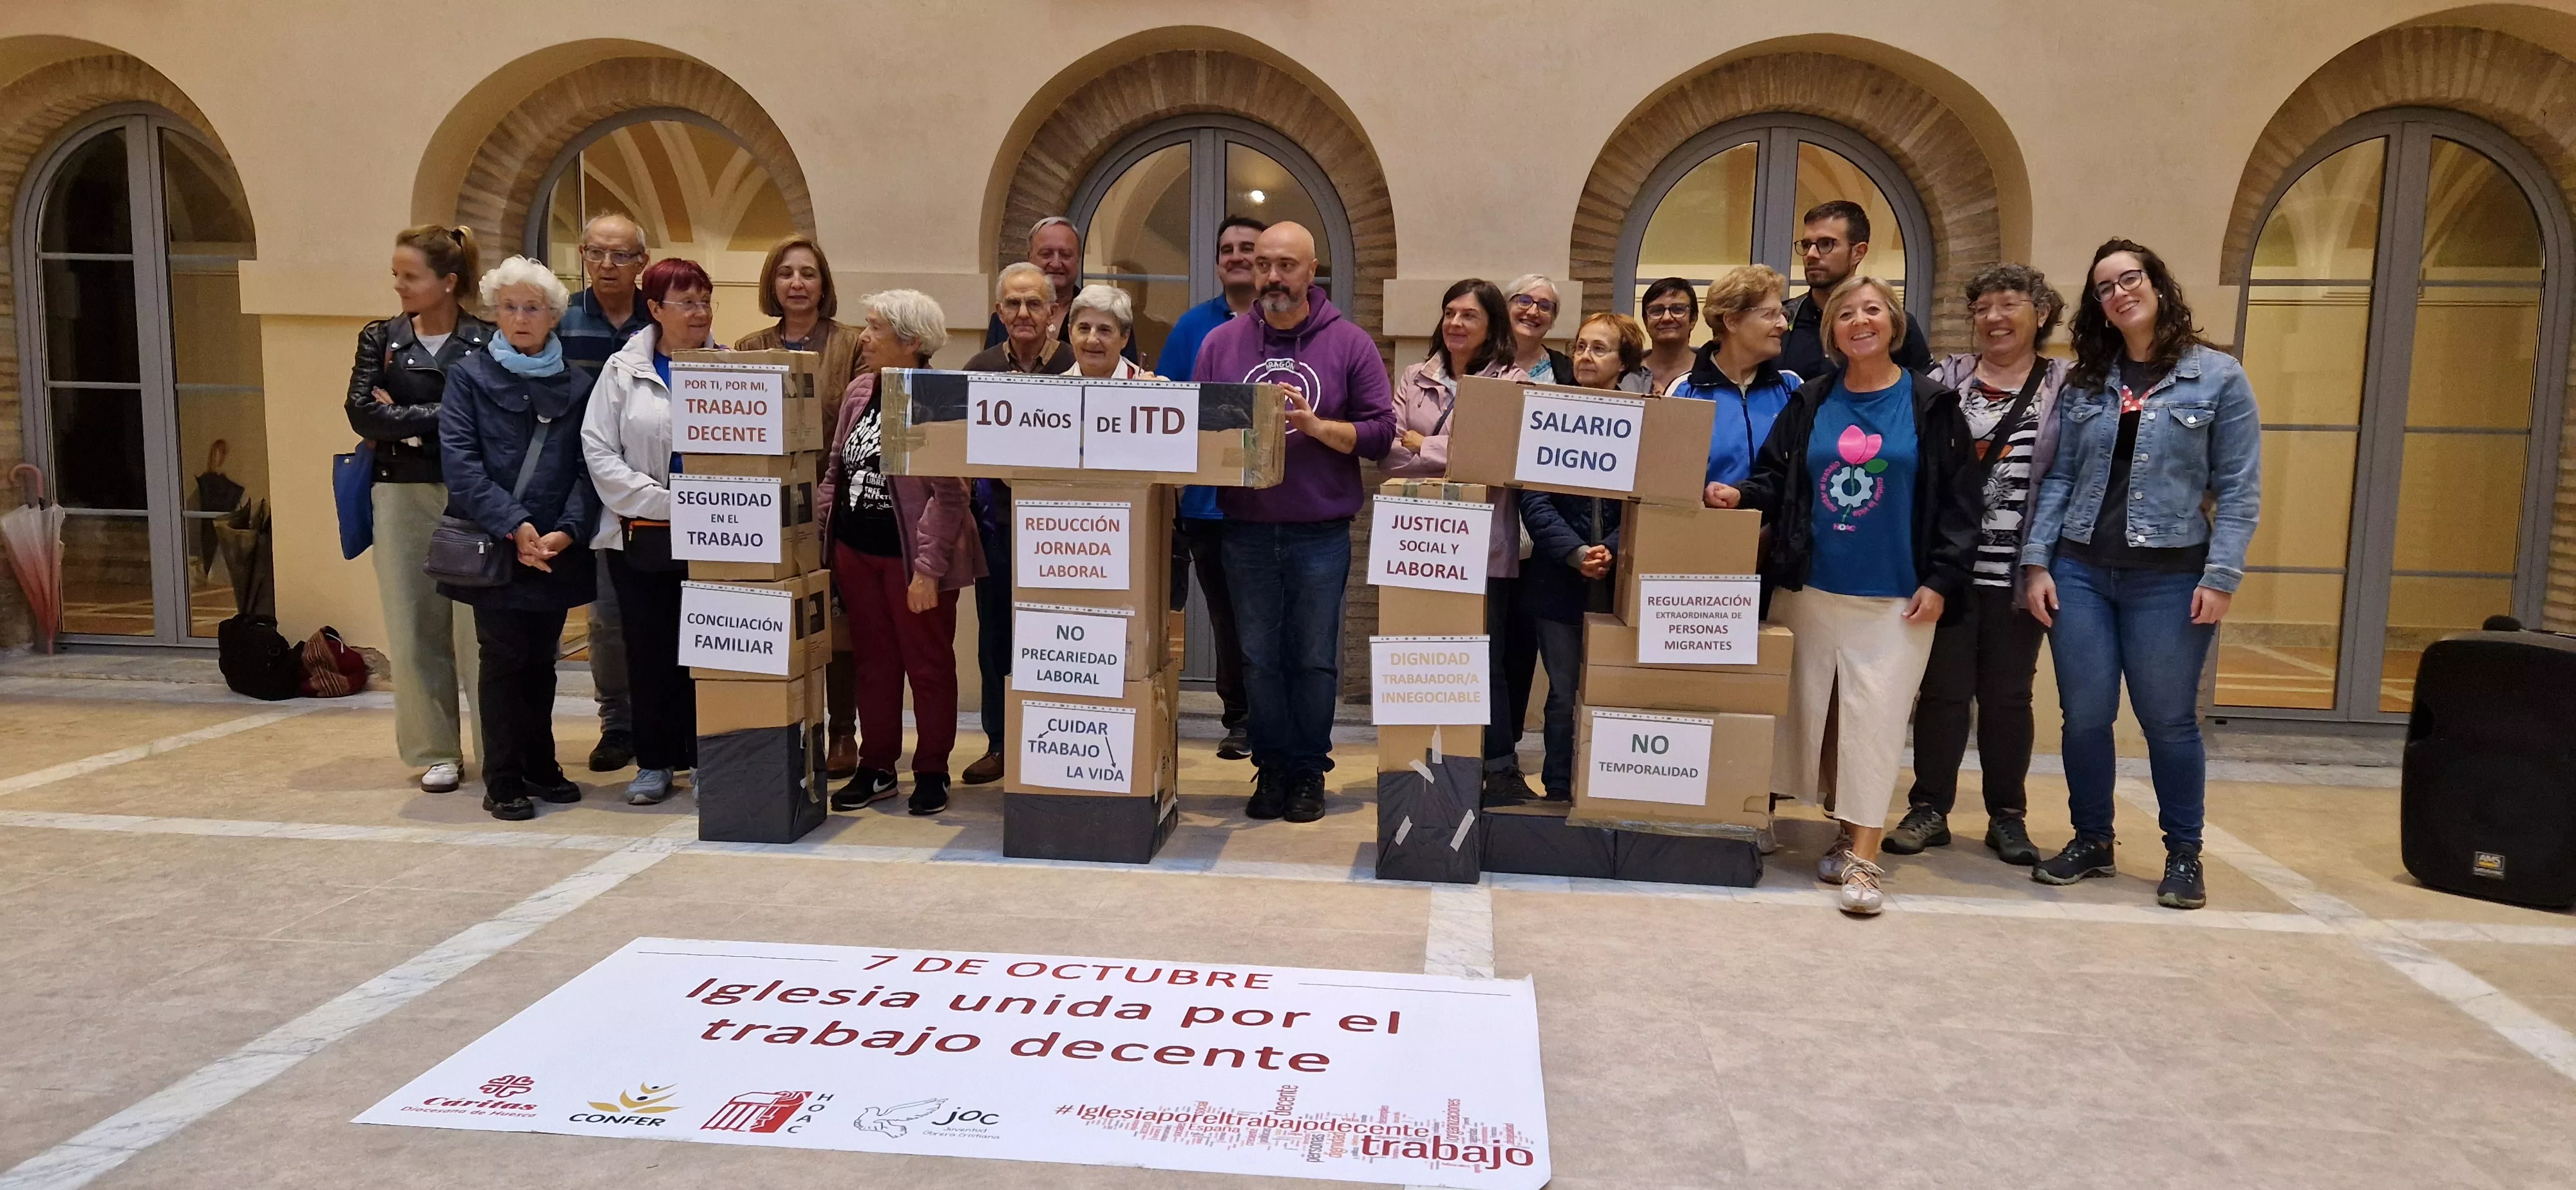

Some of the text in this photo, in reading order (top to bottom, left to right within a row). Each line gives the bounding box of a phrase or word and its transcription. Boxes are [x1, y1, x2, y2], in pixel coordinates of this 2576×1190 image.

[685, 380, 768, 392] POR TI, POR MI,
[686, 399, 767, 415] TRABAJO
[975, 399, 1072, 430] 10 AÑOS
[1097, 406, 1185, 435] DE ITD
[1530, 410, 1632, 439] SALARIO
[688, 426, 766, 442] DECENTE
[1537, 446, 1616, 471] DIGNO
[865, 486, 881, 495] FREE
[677, 491, 772, 507] SEGURIDAD
[711, 514, 739, 524] EN EL
[1025, 515, 1120, 532] REDUCCIÓN
[1391, 515, 1469, 534] JUSTICIA
[687, 531, 763, 547] TRABAJO
[1399, 540, 1459, 554] SOCIAL Y
[1034, 542, 1111, 555] JORNADA
[1039, 565, 1107, 578] LABORAL
[1387, 560, 1468, 580] LABORAL
[1648, 594, 1751, 607] REGULARIZACIÓN
[687, 613, 782, 632] CONCILIACIÓN
[1669, 625, 1728, 634] PERSONAS
[1056, 625, 1085, 641] NO
[695, 634, 773, 655] FAMILIAR
[1664, 641, 1732, 650] MIGRANTES
[1022, 648, 1117, 665] PRECARIEDAD
[1390, 652, 1470, 666] DIGNIDAD
[1037, 670, 1099, 685] LABORAL
[1382, 674, 1479, 686] TRABAJADOR/A
[1381, 692, 1481, 703] INNEGOCIABLE
[1047, 718, 1108, 735] CUIDAR
[1028, 740, 1099, 758] TRABAJO
[1631, 733, 1669, 755] NO
[1066, 766, 1124, 781] LA VIDA
[1599, 761, 1698, 778] TEMPORALIDAD
[862, 955, 1274, 990] 7 DE OCTUBRE
[686, 978, 1401, 1034] Iglesia unida por el
[701, 1019, 1331, 1073] trabajo decente
[423, 1097, 538, 1110] Cáritas
[1267, 1084, 1298, 1116] decente
[569, 1113, 667, 1128] CONFER
[1188, 1123, 1240, 1133] España
[1446, 1099, 1464, 1141] organizaciones
[1307, 1134, 1325, 1163] personas
[1324, 1131, 1348, 1158] dignidad
[1361, 1134, 1534, 1170] trabajo
